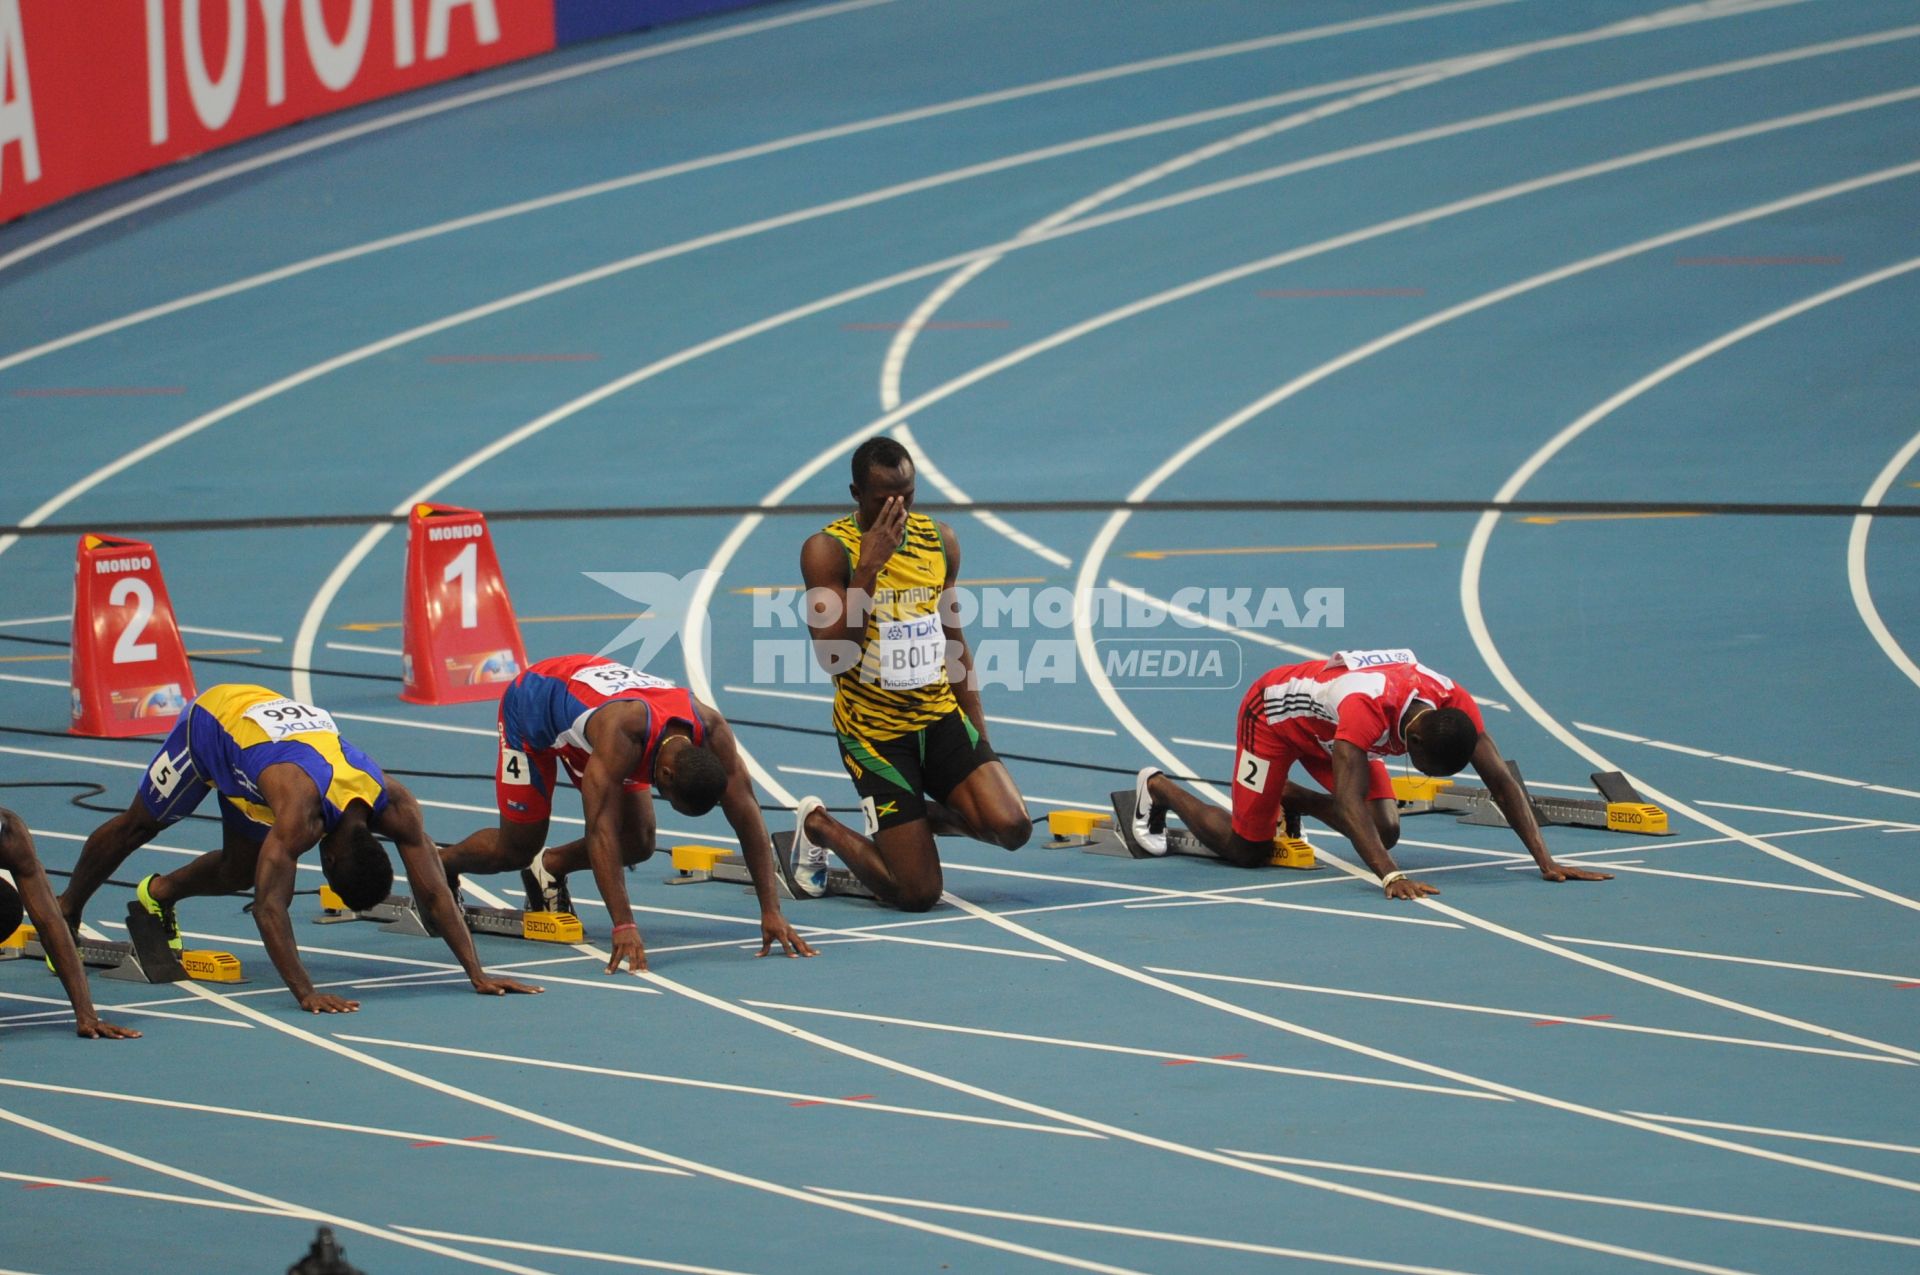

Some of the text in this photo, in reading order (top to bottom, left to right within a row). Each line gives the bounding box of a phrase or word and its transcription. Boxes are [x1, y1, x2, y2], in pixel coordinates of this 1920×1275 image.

[428, 524, 484, 542] MONDO
[95, 556, 152, 575] MONDO
[443, 542, 478, 629] 1
[109, 577, 158, 665] 2
[902, 617, 938, 639] TDK
[892, 641, 940, 671] BOLT
[1353, 653, 1394, 668] TDK
[263, 705, 318, 722] 166
[274, 720, 324, 736] TDK
[156, 766, 172, 786] 5
[506, 755, 521, 779] 4
[1243, 760, 1258, 786] 2
[1609, 811, 1643, 825] SEIKO
[526, 920, 557, 934] SEIKO
[185, 959, 215, 974] SEIKO
